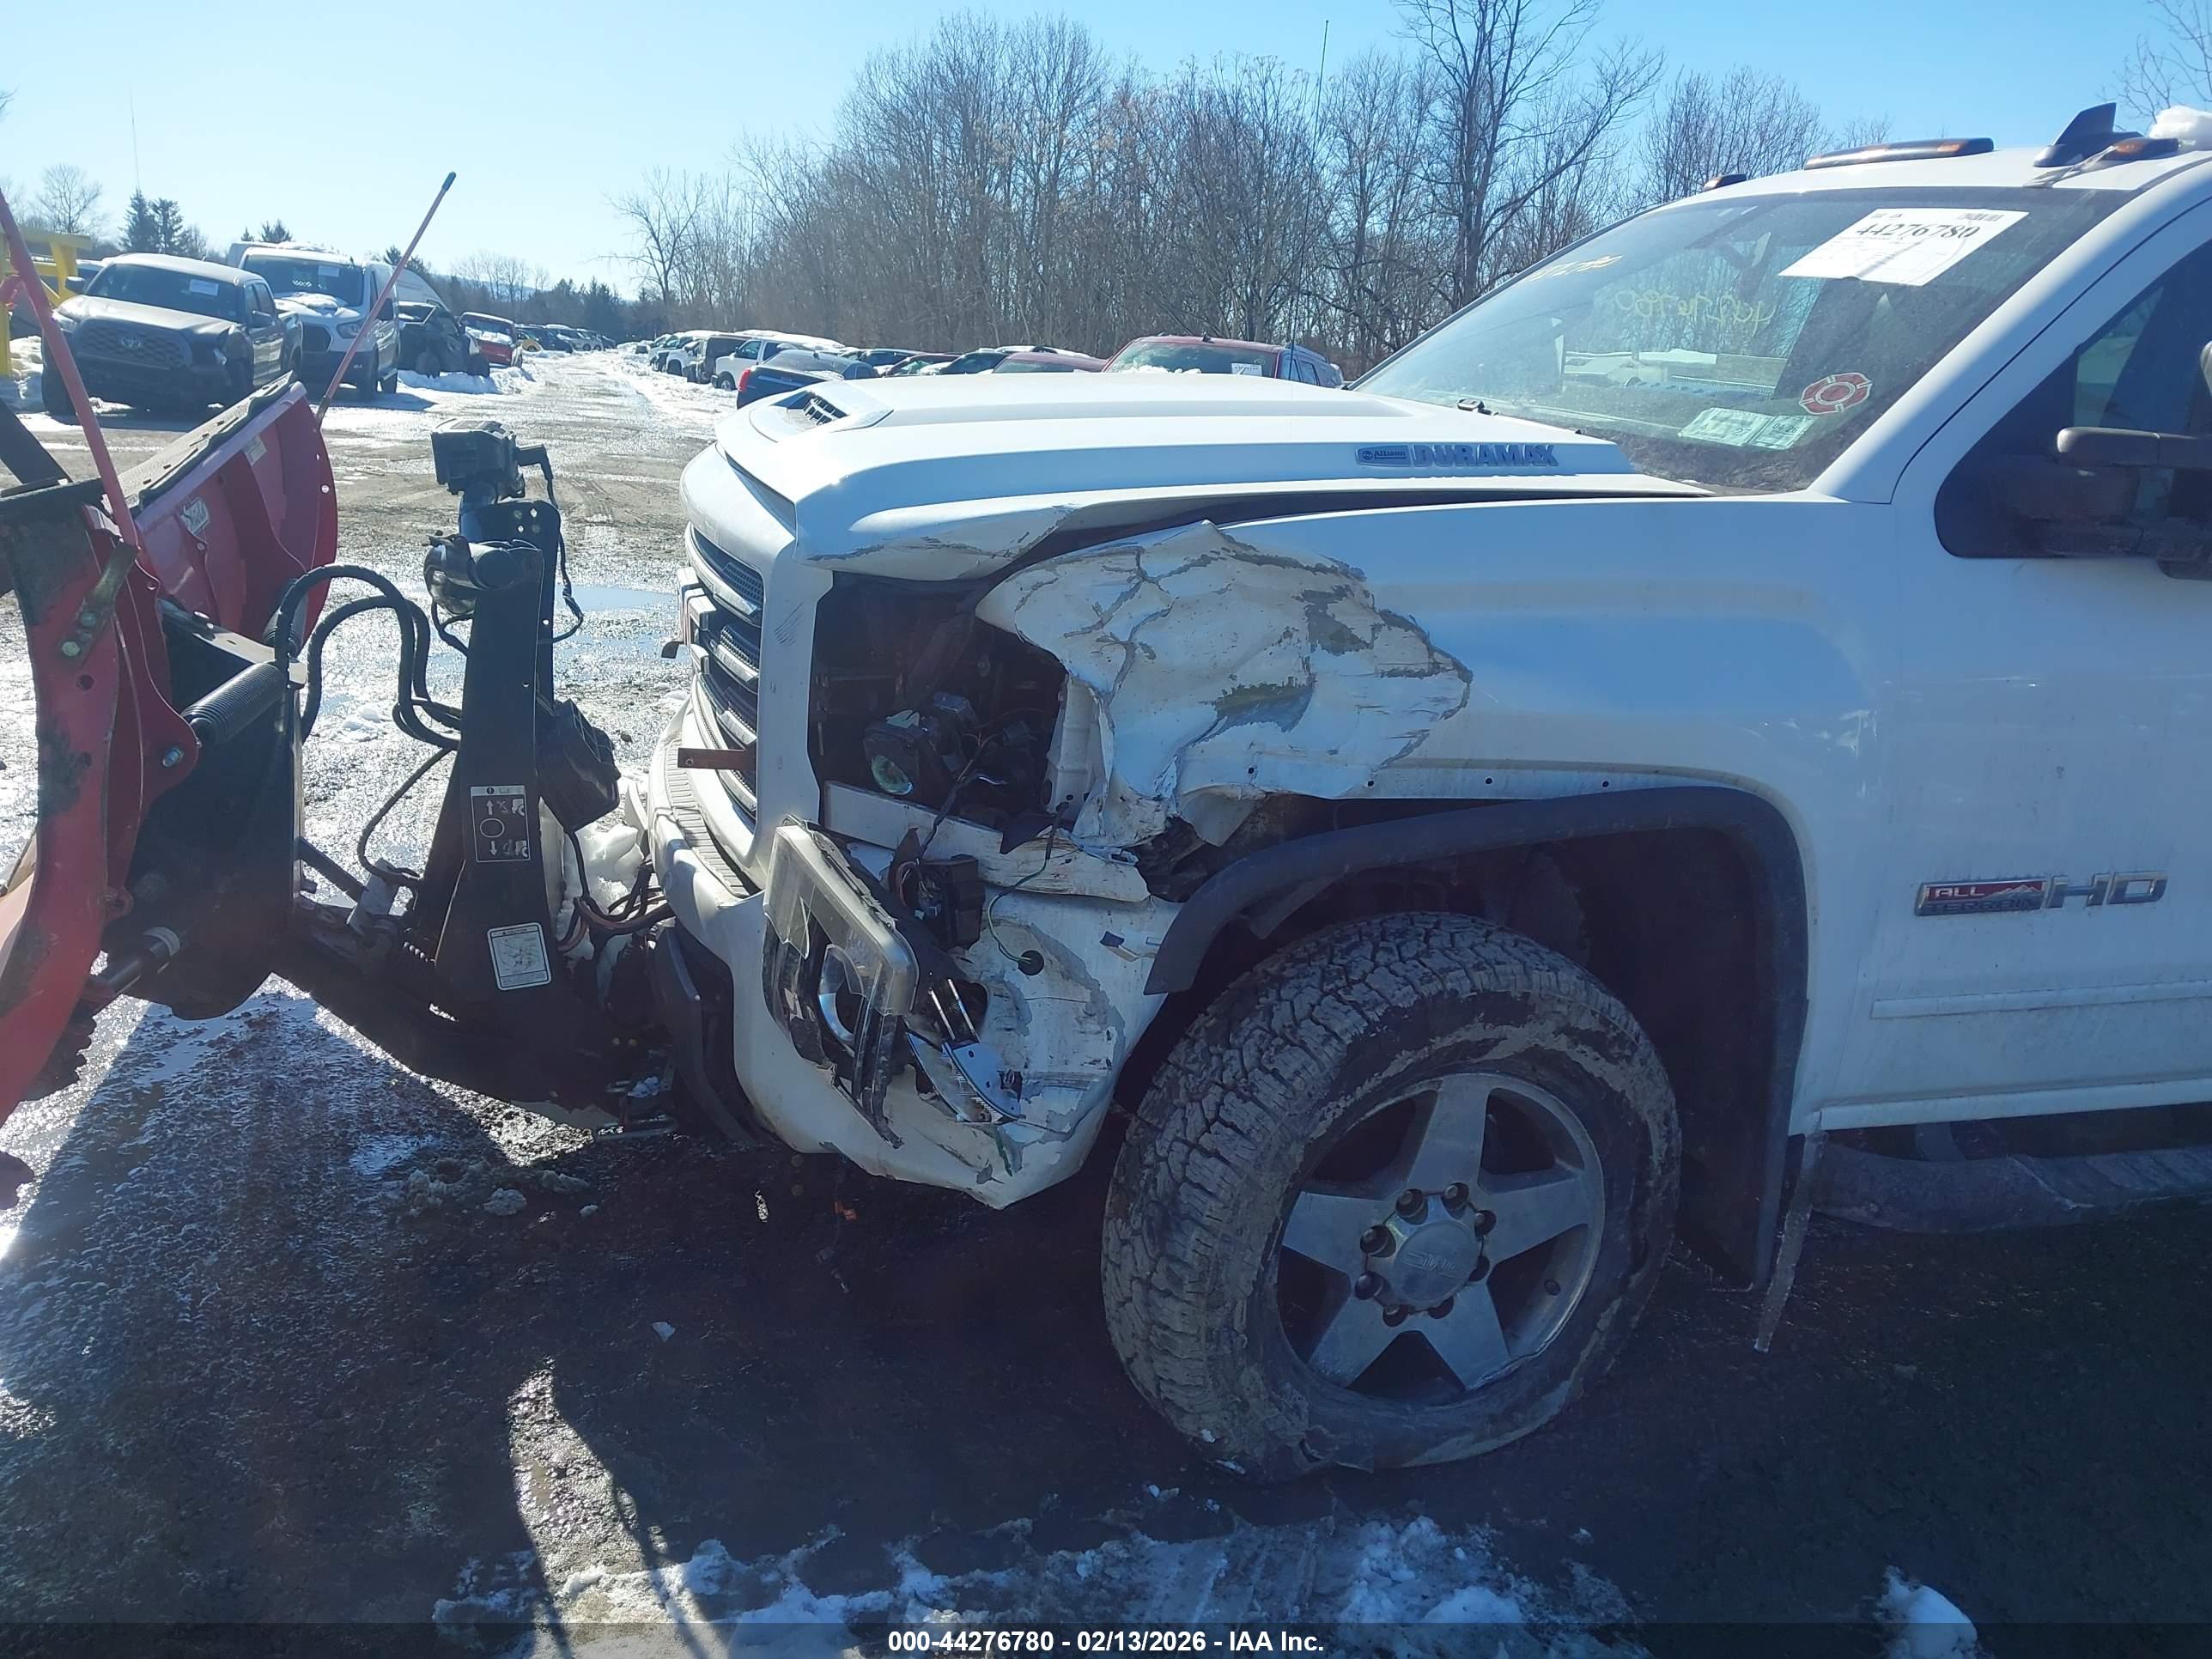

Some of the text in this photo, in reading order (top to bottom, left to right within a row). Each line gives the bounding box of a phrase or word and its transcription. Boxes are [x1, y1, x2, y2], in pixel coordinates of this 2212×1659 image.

[1856, 223, 1981, 240] 44276780
[1413, 444, 1559, 467] DURAMAX
[1935, 871, 2168, 908] ALL HD
[1925, 896, 2041, 915] TERRAIN
